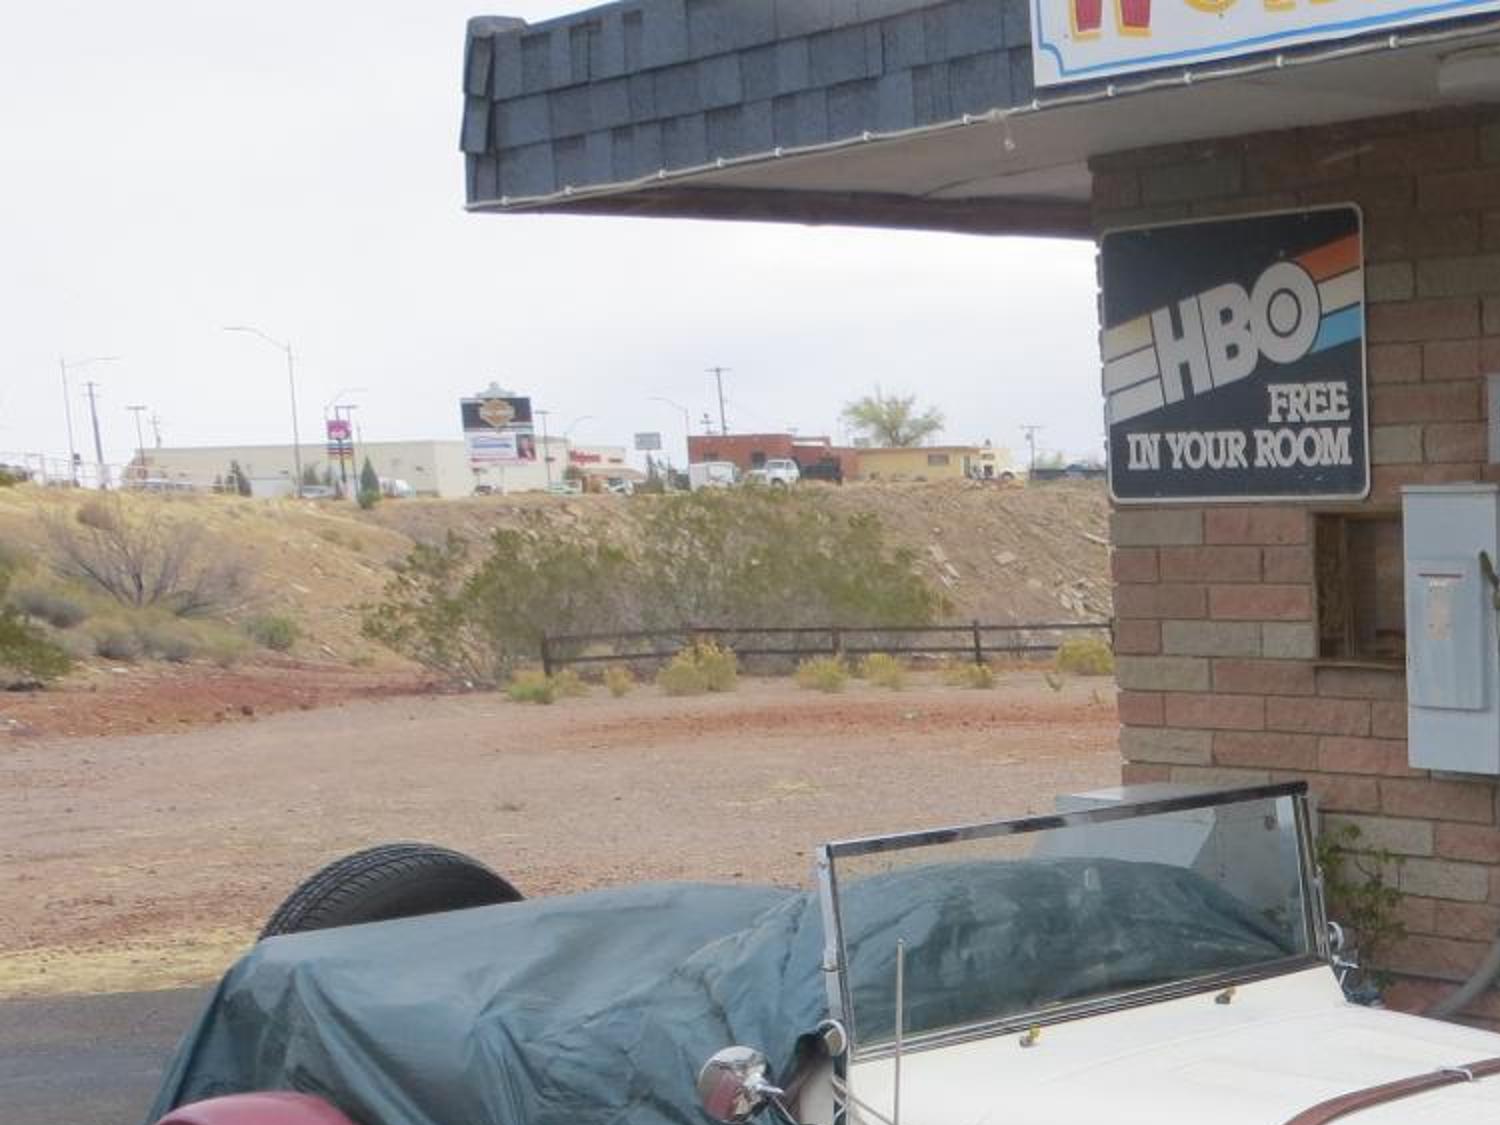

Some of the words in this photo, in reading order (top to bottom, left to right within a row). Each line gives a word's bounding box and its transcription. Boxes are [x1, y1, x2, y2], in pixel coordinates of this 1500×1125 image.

[1151, 260, 1322, 406] HBO
[1267, 381, 1351, 423] FREE
[1127, 432, 1162, 471] IN
[1164, 430, 1249, 471] YOUR
[1253, 427, 1353, 468] ROOM
